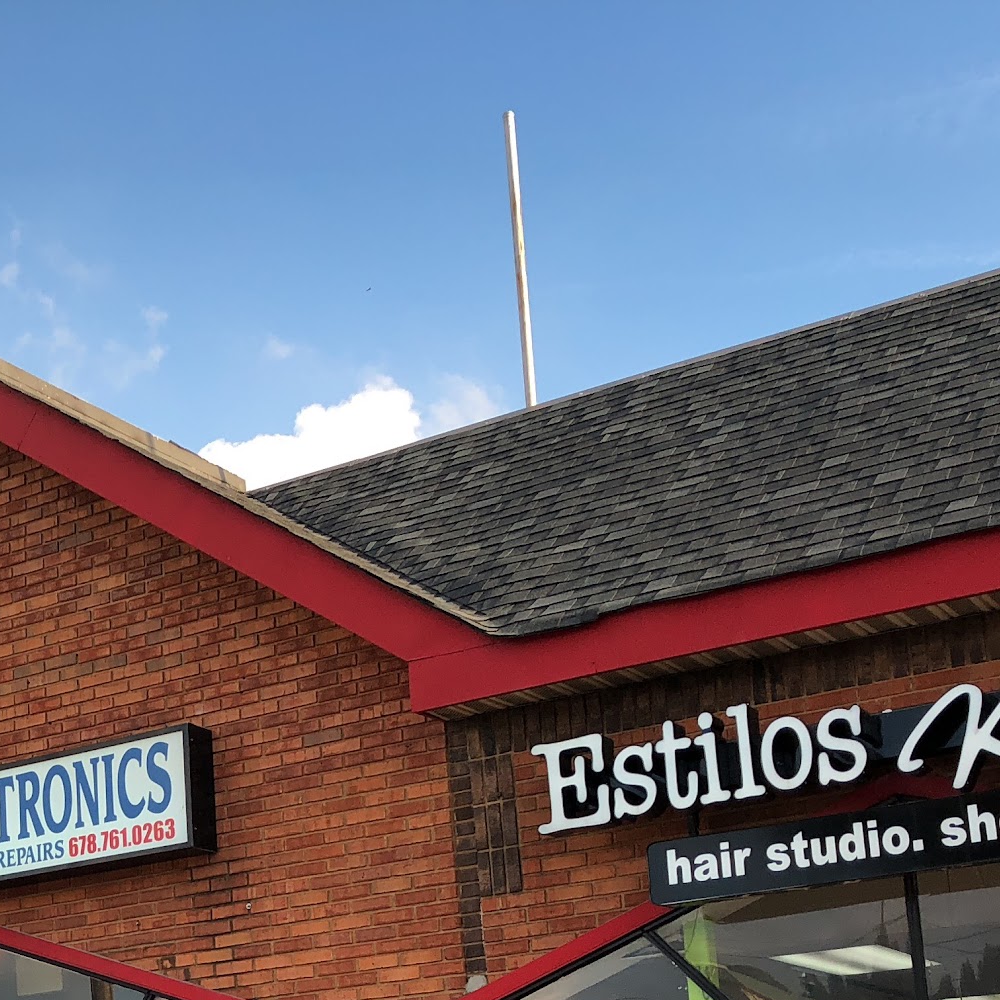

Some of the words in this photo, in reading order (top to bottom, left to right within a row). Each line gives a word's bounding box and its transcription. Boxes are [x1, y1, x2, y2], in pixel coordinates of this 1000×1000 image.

[531, 703, 868, 835] Estilos
[68, 818, 176, 858] 678.761.0263
[666, 840, 751, 886] hair
[766, 819, 924, 872] studio.
[940, 803, 1000, 847] sh
